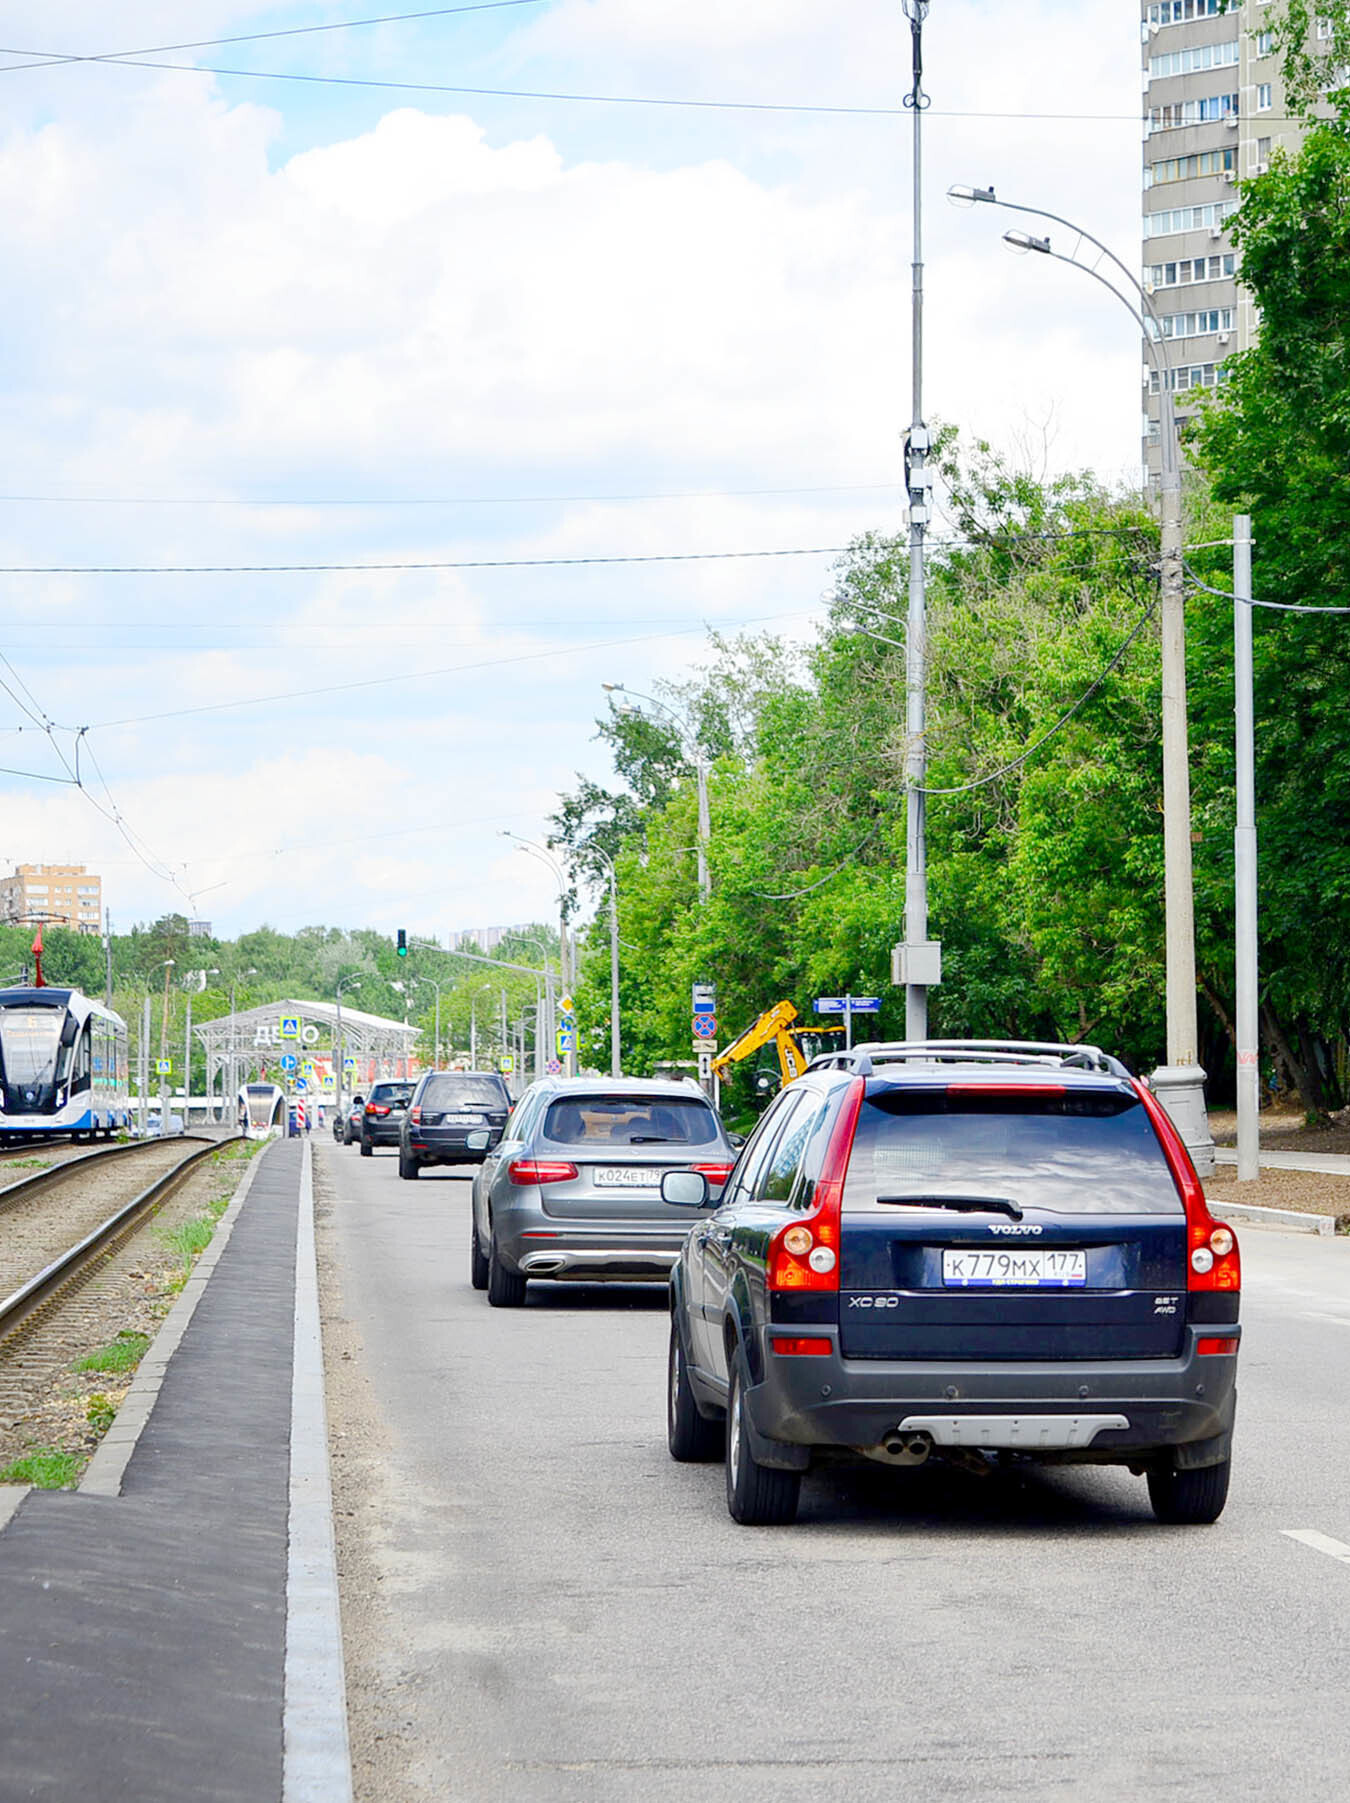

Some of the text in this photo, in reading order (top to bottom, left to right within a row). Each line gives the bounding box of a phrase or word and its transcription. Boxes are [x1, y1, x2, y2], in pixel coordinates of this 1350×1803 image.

[254, 1025, 320, 1047] ДЕО
[784, 1048, 798, 1078] JCB
[988, 1224, 1043, 1235] VOLVO
[952, 1253, 1079, 1277] К779МХ 177
